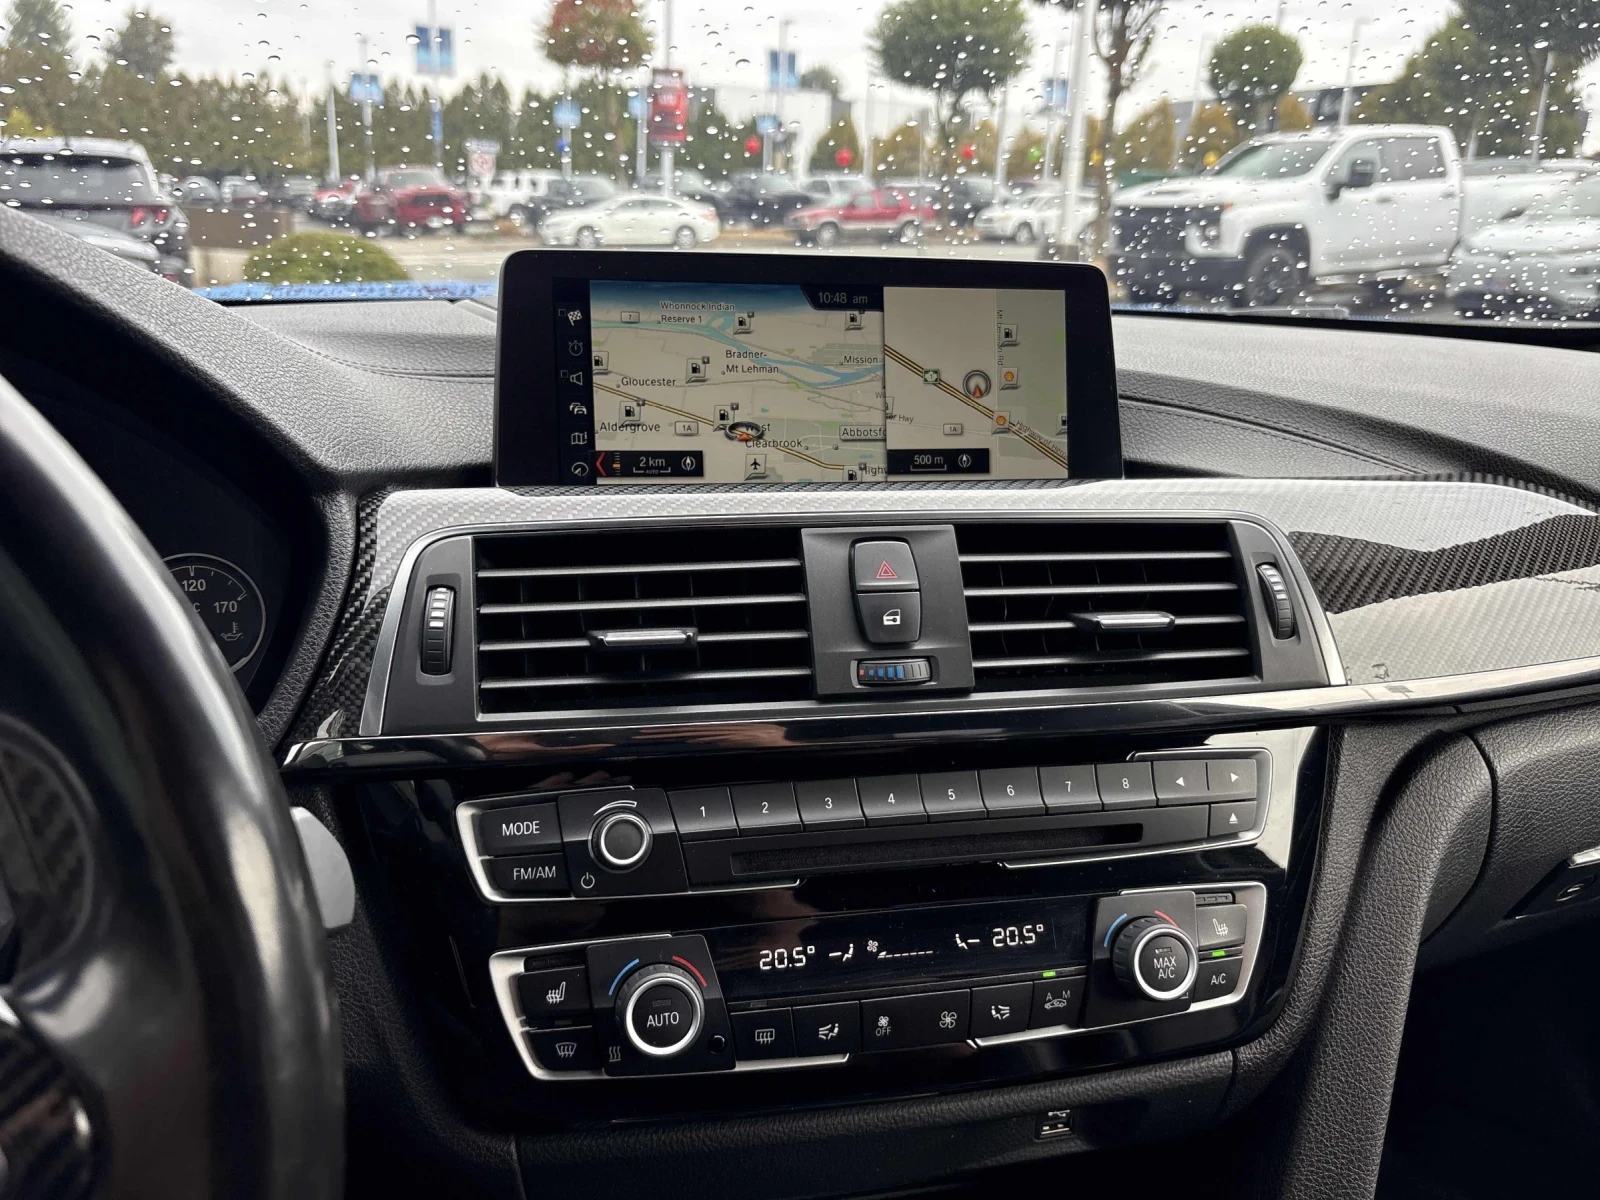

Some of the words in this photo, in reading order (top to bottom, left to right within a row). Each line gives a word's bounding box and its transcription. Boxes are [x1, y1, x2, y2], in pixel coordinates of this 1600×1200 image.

[818, 292, 847, 304] 10:48
[852, 295, 868, 304] am
[660, 301, 705, 310] Whonnock
[708, 302, 735, 311] Indian
[661, 315, 695, 323] Reserve
[698, 315, 702, 323] 1
[725, 350, 767, 359] Bradner-
[843, 355, 878, 363] Mission
[997, 355, 1004, 366] Rd
[726, 365, 739, 373] Mt
[741, 364, 779, 373] Lehman
[621, 376, 676, 387] Gloucester
[898, 414, 914, 424] Hwy
[599, 422, 661, 433] Aldergrove
[1015, 420, 1043, 443] Highway
[745, 438, 803, 448] Clearbrook
[639, 456, 646, 467] 2
[648, 456, 666, 467] km
[914, 455, 931, 465] 500
[934, 455, 944, 464] m
[182, 579, 206, 592] 120
[213, 600, 238, 613] 170
[1064, 781, 1072, 793] 7
[1122, 777, 1129, 789] 8
[948, 788, 955, 801] 5
[1006, 784, 1015, 797] 6
[824, 797, 833, 810] 3
[887, 793, 895, 805] 4
[699, 805, 706, 818] 1
[761, 801, 769, 814] 2
[502, 819, 540, 837] MODE
[513, 866, 557, 881] FM/AM
[1153, 956, 1177, 969] MAX
[1158, 967, 1176, 979] A/C
[1210, 973, 1227, 985] A/C
[1045, 992, 1053, 1001] A
[1062, 989, 1071, 999] M
[646, 1012, 680, 1028] AUTO
[875, 1026, 892, 1037] OFF
